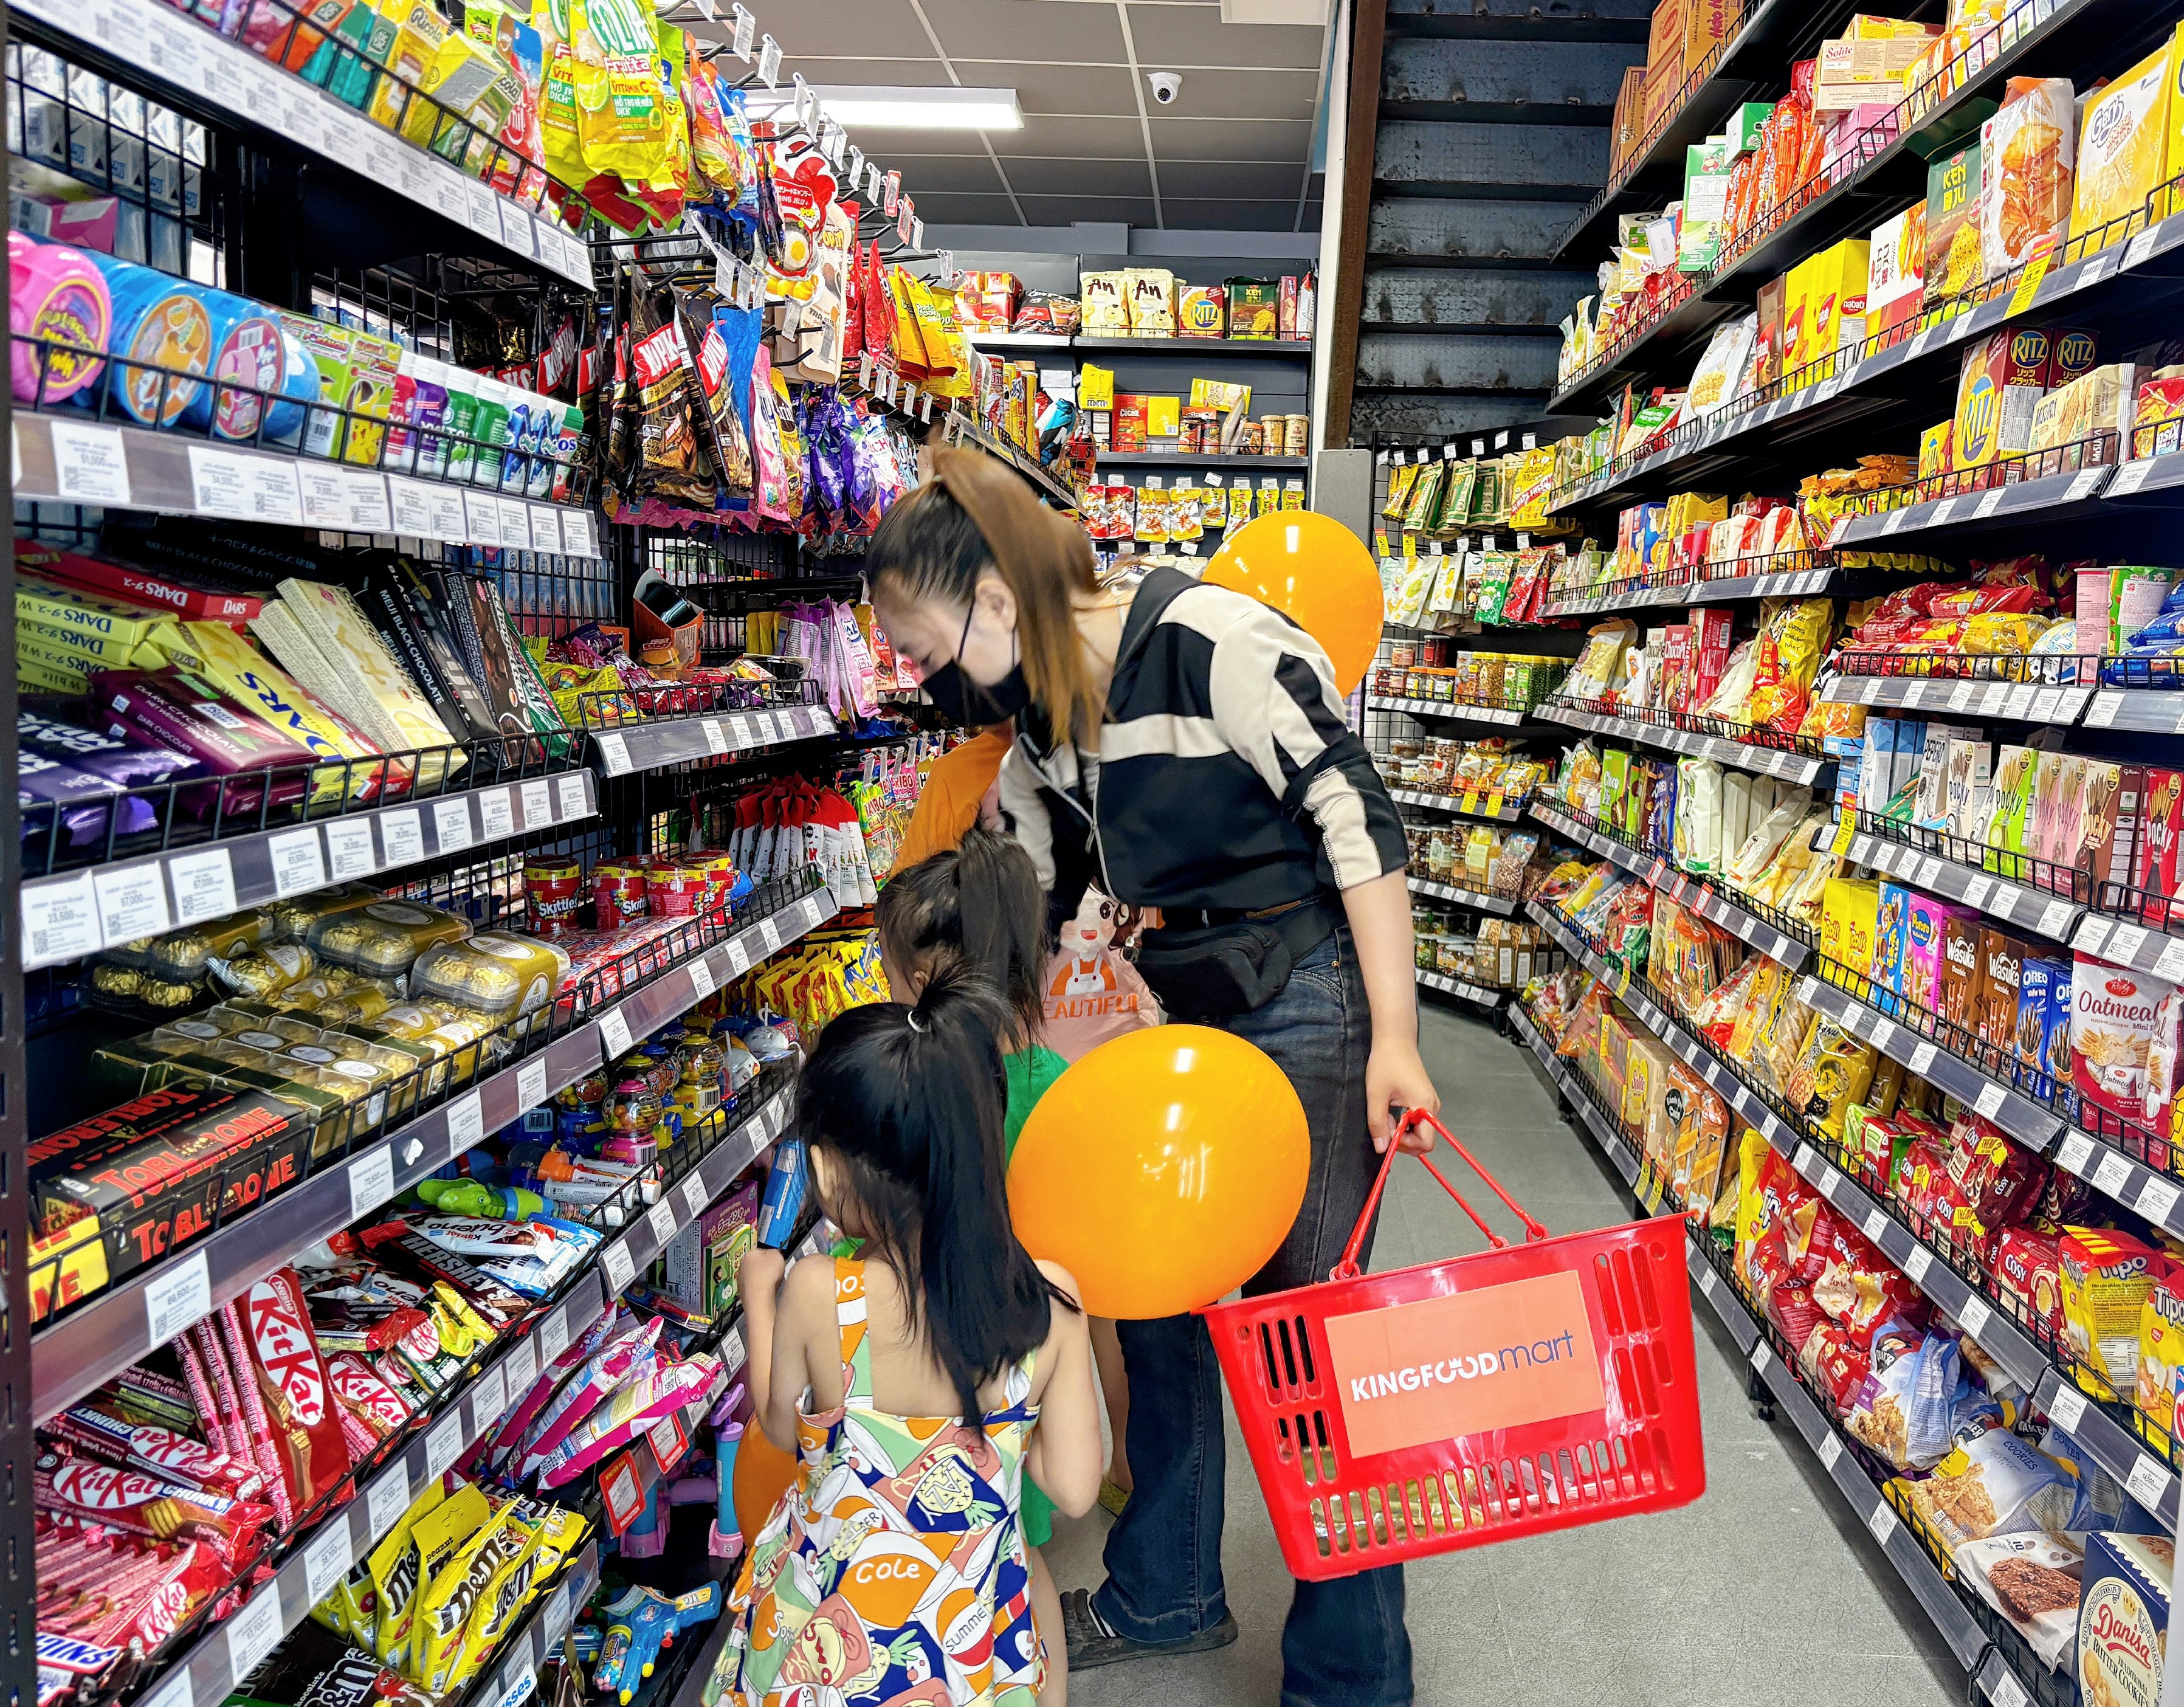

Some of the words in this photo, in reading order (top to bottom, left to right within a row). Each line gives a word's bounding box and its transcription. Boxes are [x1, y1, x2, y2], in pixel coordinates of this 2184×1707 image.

[410, 7, 443, 44] Ricola
[602, 55, 652, 74] Frutta
[1825, 45, 1853, 60] Solite
[611, 82, 640, 94] VITAMIN
[639, 81, 650, 94] C
[2090, 95, 2124, 149] Gery
[1942, 162, 1967, 190] KEN
[1087, 278, 1115, 295] An
[1135, 279, 1162, 300] An
[1191, 306, 1219, 325] RITZ
[1842, 300, 1865, 310] nabati
[2011, 334, 2048, 364] RITZ
[2058, 338, 2095, 366] RITZ
[2009, 376, 2042, 387] クラッカー
[2016, 368, 2036, 378] リッツ
[1961, 385, 1994, 452] RITZ
[2092, 428, 2103, 462] MISURA
[145, 583, 188, 606] DARS
[222, 599, 247, 615] DARS
[63, 610, 112, 633] DARS
[61, 630, 104, 655] DARS
[379, 588, 399, 616] MEIJI
[393, 614, 415, 650] BLACK
[409, 647, 445, 706] CHOCOLATE
[41, 670, 82, 693] White
[134, 684, 168, 706] DARK
[165, 700, 243, 756] CHOCOLATE
[236, 671, 343, 762] DARS
[1924, 739, 1945, 763] PEPERO
[1949, 781, 1971, 806] POCKY
[1996, 788, 2023, 816] POCKY
[2057, 801, 2079, 832] POCKY
[2082, 811, 2112, 845] POCKY
[2146, 819, 2175, 853] POCKY
[538, 898, 579, 916] Skittles
[622, 900, 649, 914] Skitt
[1946, 937, 1975, 970] Wasuka
[1989, 952, 2020, 988] Wasuka
[2023, 970, 2048, 986] OREO
[1041, 993, 1140, 1020] EAUTIFUL
[2056, 985, 2073, 1002] OR
[2078, 990, 2160, 1023] Oatmeal
[2103, 1072, 2129, 1088] Oatmea
[1964, 1126, 1980, 1147] COSY
[1900, 1157, 1914, 1178] COSY
[1994, 1176, 2010, 1196] COSY
[1936, 1195, 1955, 1220] COSY
[427, 1219, 505, 1238] bueno
[405, 1233, 515, 1304] HERSHEY'S
[2005, 1253, 2028, 1283] COSY
[410, 1318, 439, 1359] KitKat
[250, 1298, 323, 1425] KitKat
[332, 1364, 402, 1428] KitKat
[75, 1407, 134, 1433] CHUNKY
[2003, 1440, 2039, 1472] COOKIES
[60, 1465, 159, 1509] KitKat
[162, 1482, 235, 1515] CHUNKY
[425, 1535, 454, 1562] peanut
[146, 1582, 187, 1640] KitKat
[944, 1605, 989, 1654] SUMME
[2092, 1603, 2152, 1671] Danisa
[2092, 1635, 2120, 1676] BUTTER
[2117, 1669, 2151, 1707] COOKIES
[2117, 1654, 2149, 1697] TRADITIONAL
